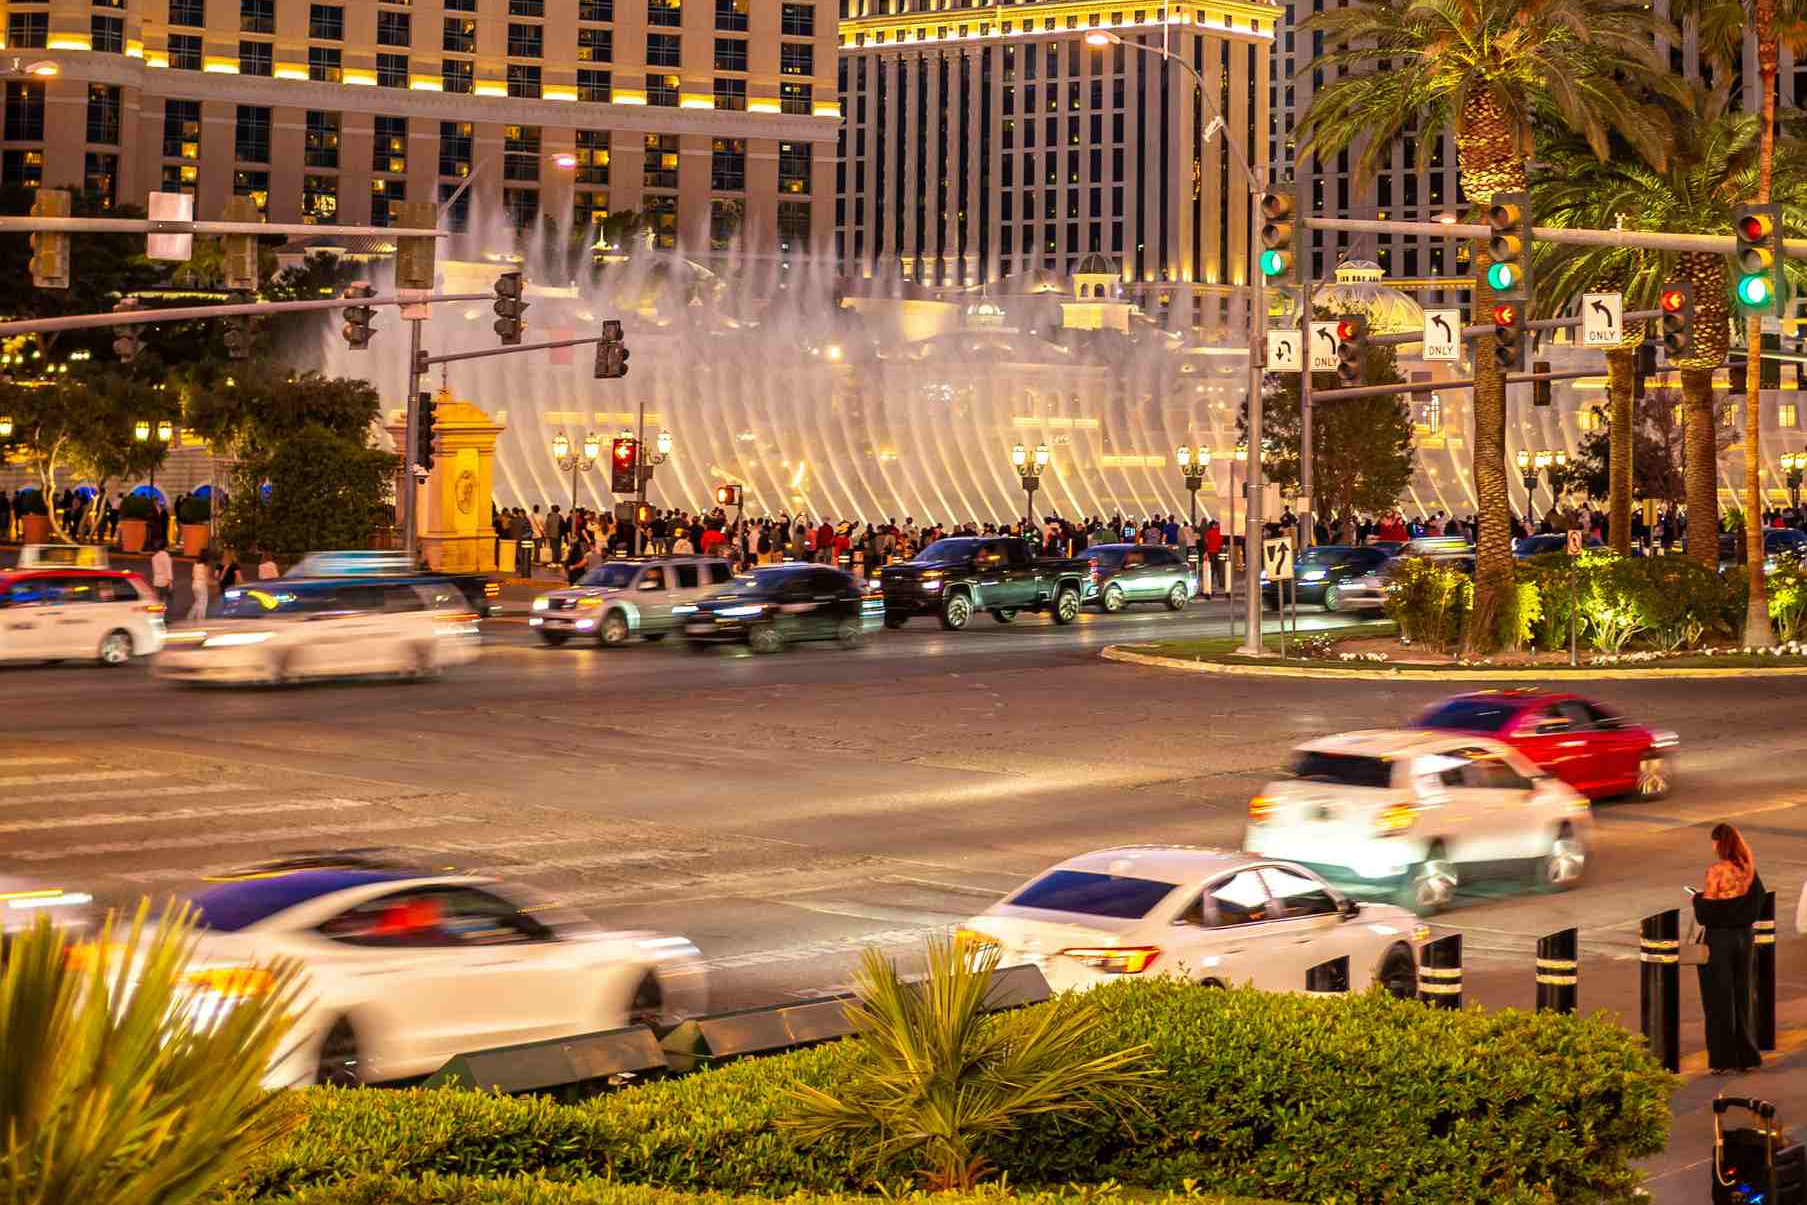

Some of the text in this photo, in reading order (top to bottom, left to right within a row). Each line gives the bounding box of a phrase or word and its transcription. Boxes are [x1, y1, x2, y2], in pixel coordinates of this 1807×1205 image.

[1589, 330, 1616, 341] ONLY
[1429, 346, 1453, 356] ONLY
[1314, 356, 1338, 367] ONLY
